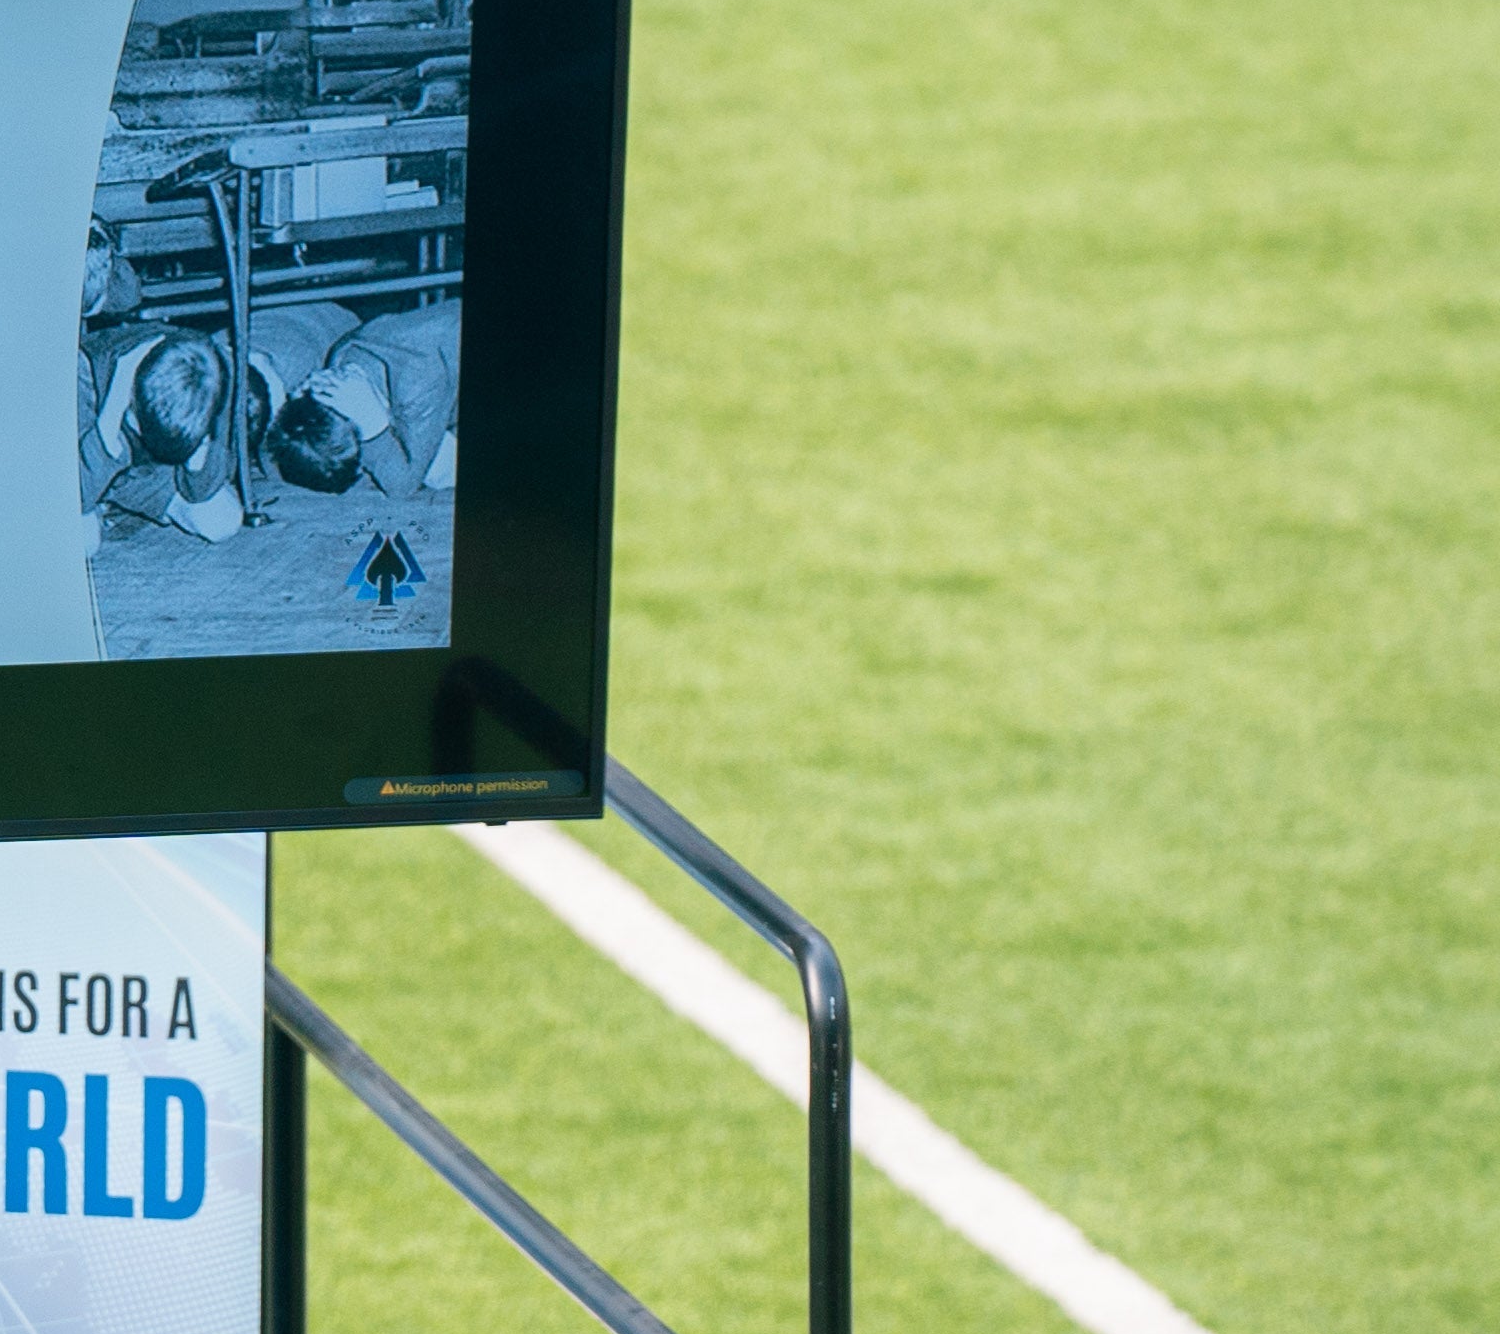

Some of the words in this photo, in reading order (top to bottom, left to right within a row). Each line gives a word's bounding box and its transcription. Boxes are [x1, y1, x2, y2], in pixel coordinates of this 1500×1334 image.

[395, 781, 474, 797] Microphone
[476, 778, 549, 795] permission
[59, 972, 149, 1038] FOR
[168, 977, 198, 1041] A
